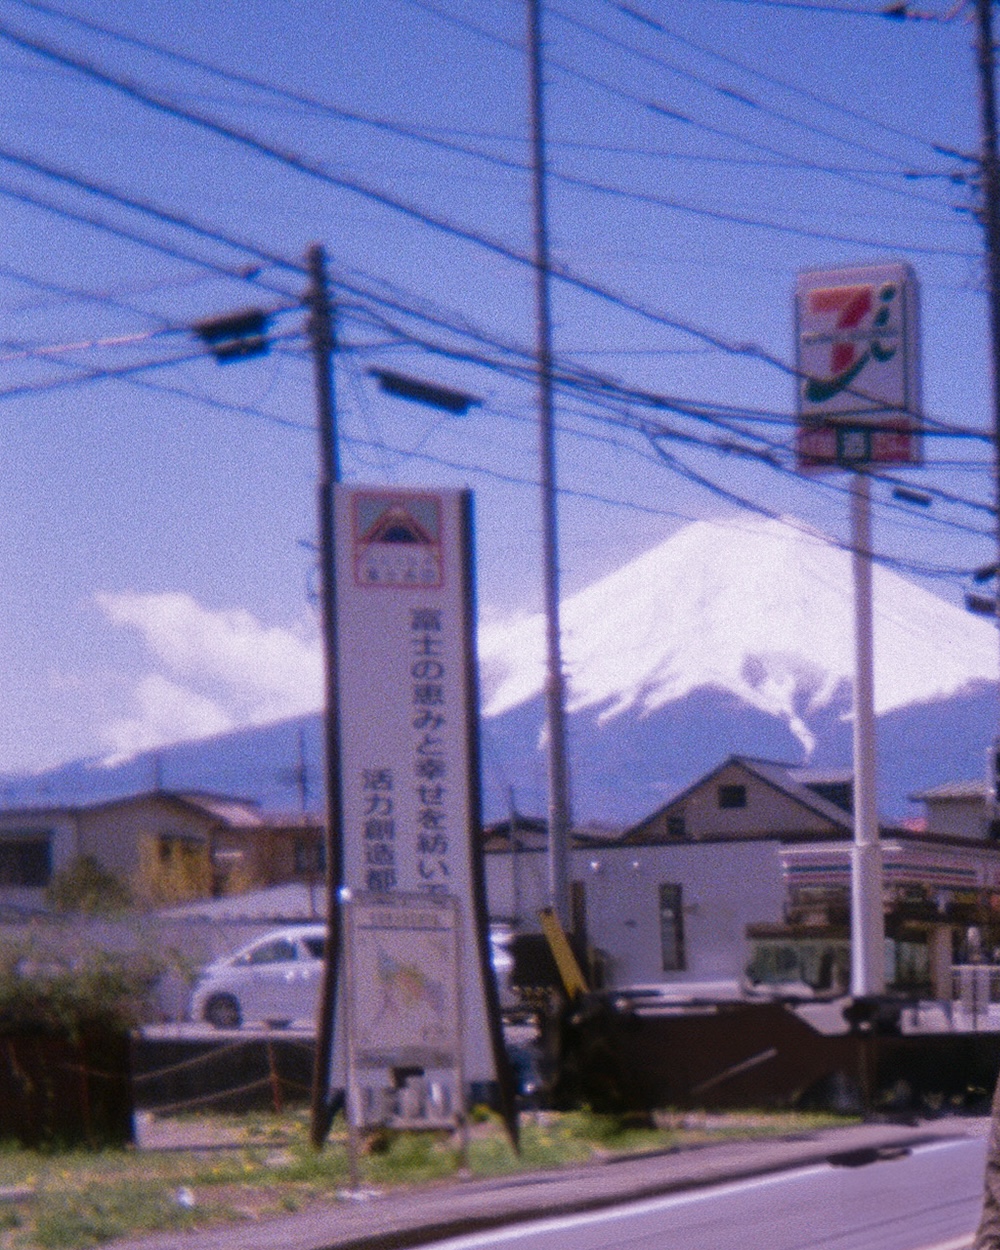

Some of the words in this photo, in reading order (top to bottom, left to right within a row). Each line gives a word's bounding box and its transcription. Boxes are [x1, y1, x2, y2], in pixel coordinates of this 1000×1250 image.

[362, 769, 397, 896] 活力創造都
